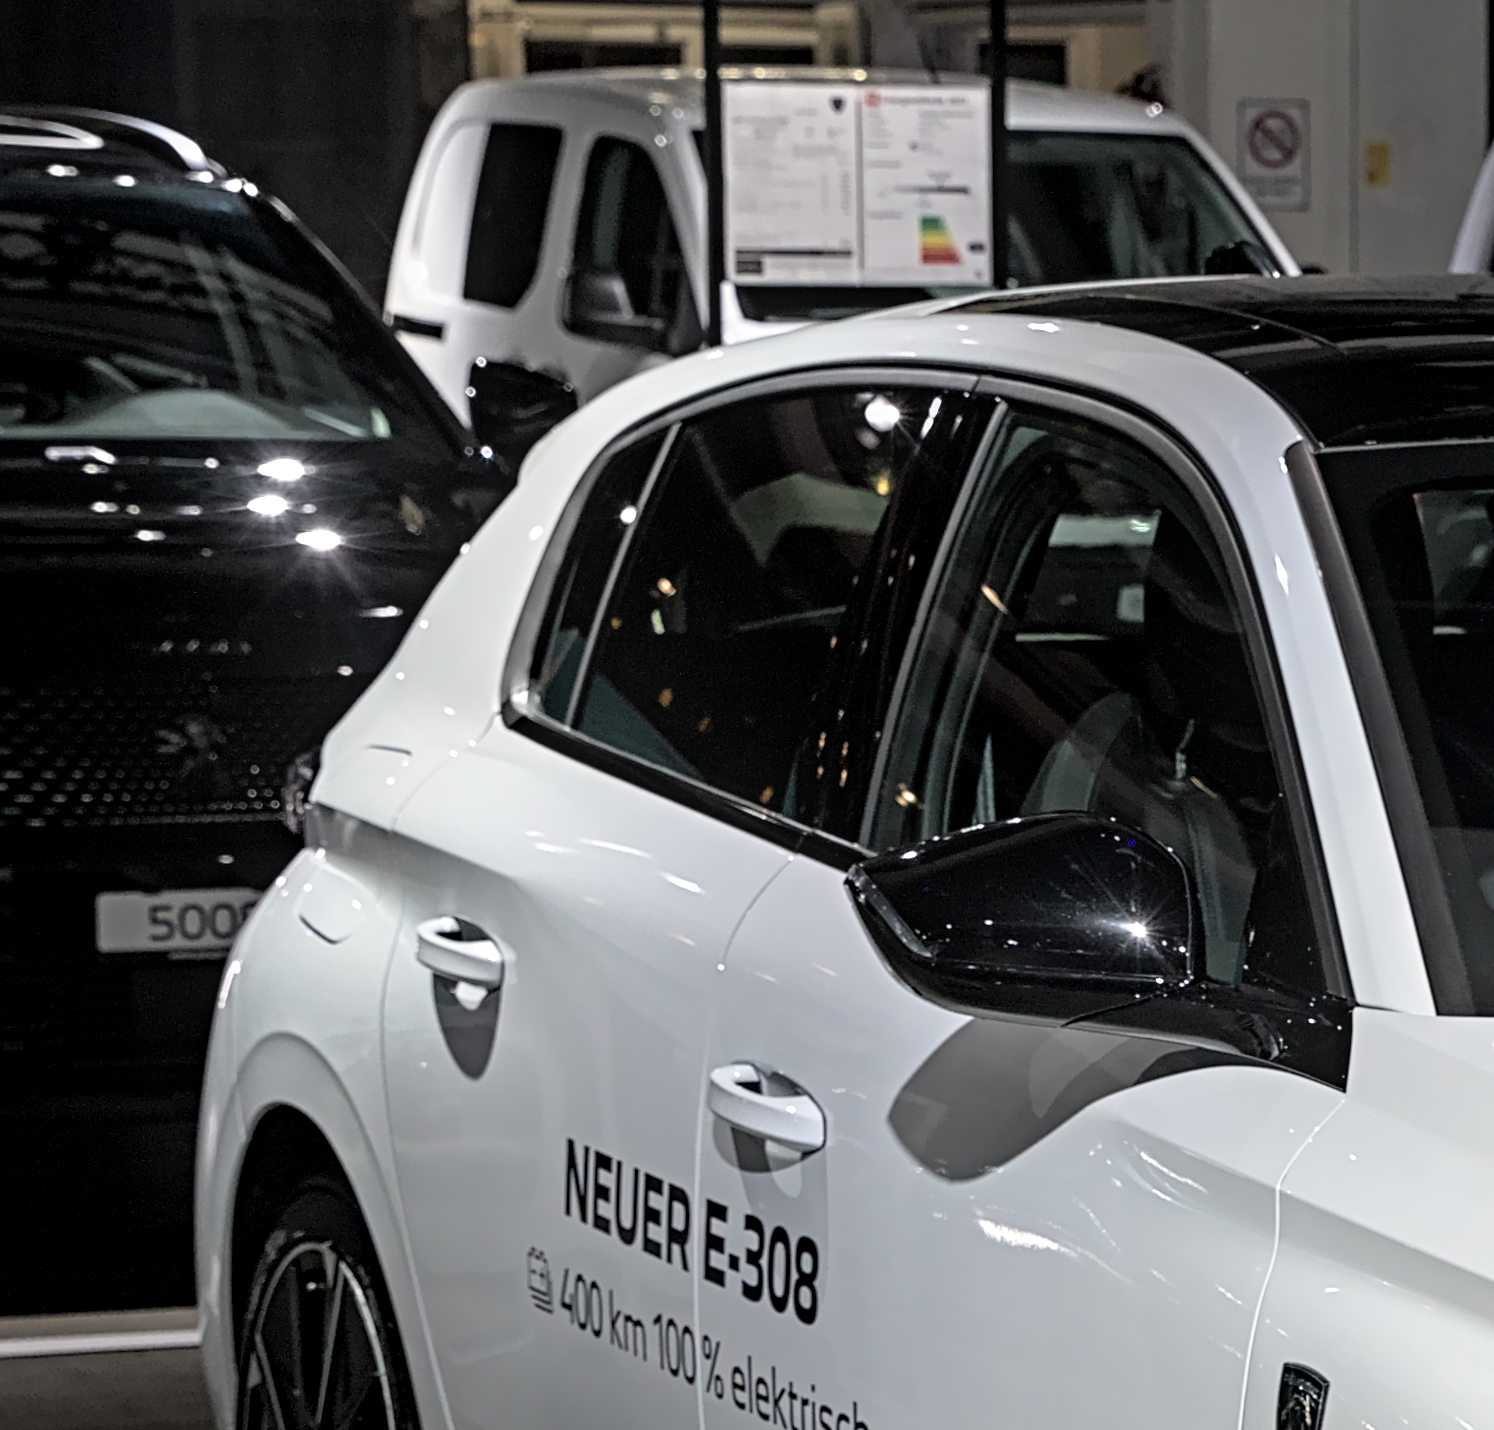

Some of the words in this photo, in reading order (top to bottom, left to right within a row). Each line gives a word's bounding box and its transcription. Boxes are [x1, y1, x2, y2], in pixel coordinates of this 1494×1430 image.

[564, 1138, 690, 1272] NEUER
[702, 1197, 820, 1326] E-308
[559, 1267, 603, 1338] 400
[609, 1289, 648, 1363] km
[652, 1313, 697, 1386] 100
[702, 1334, 725, 1400] %
